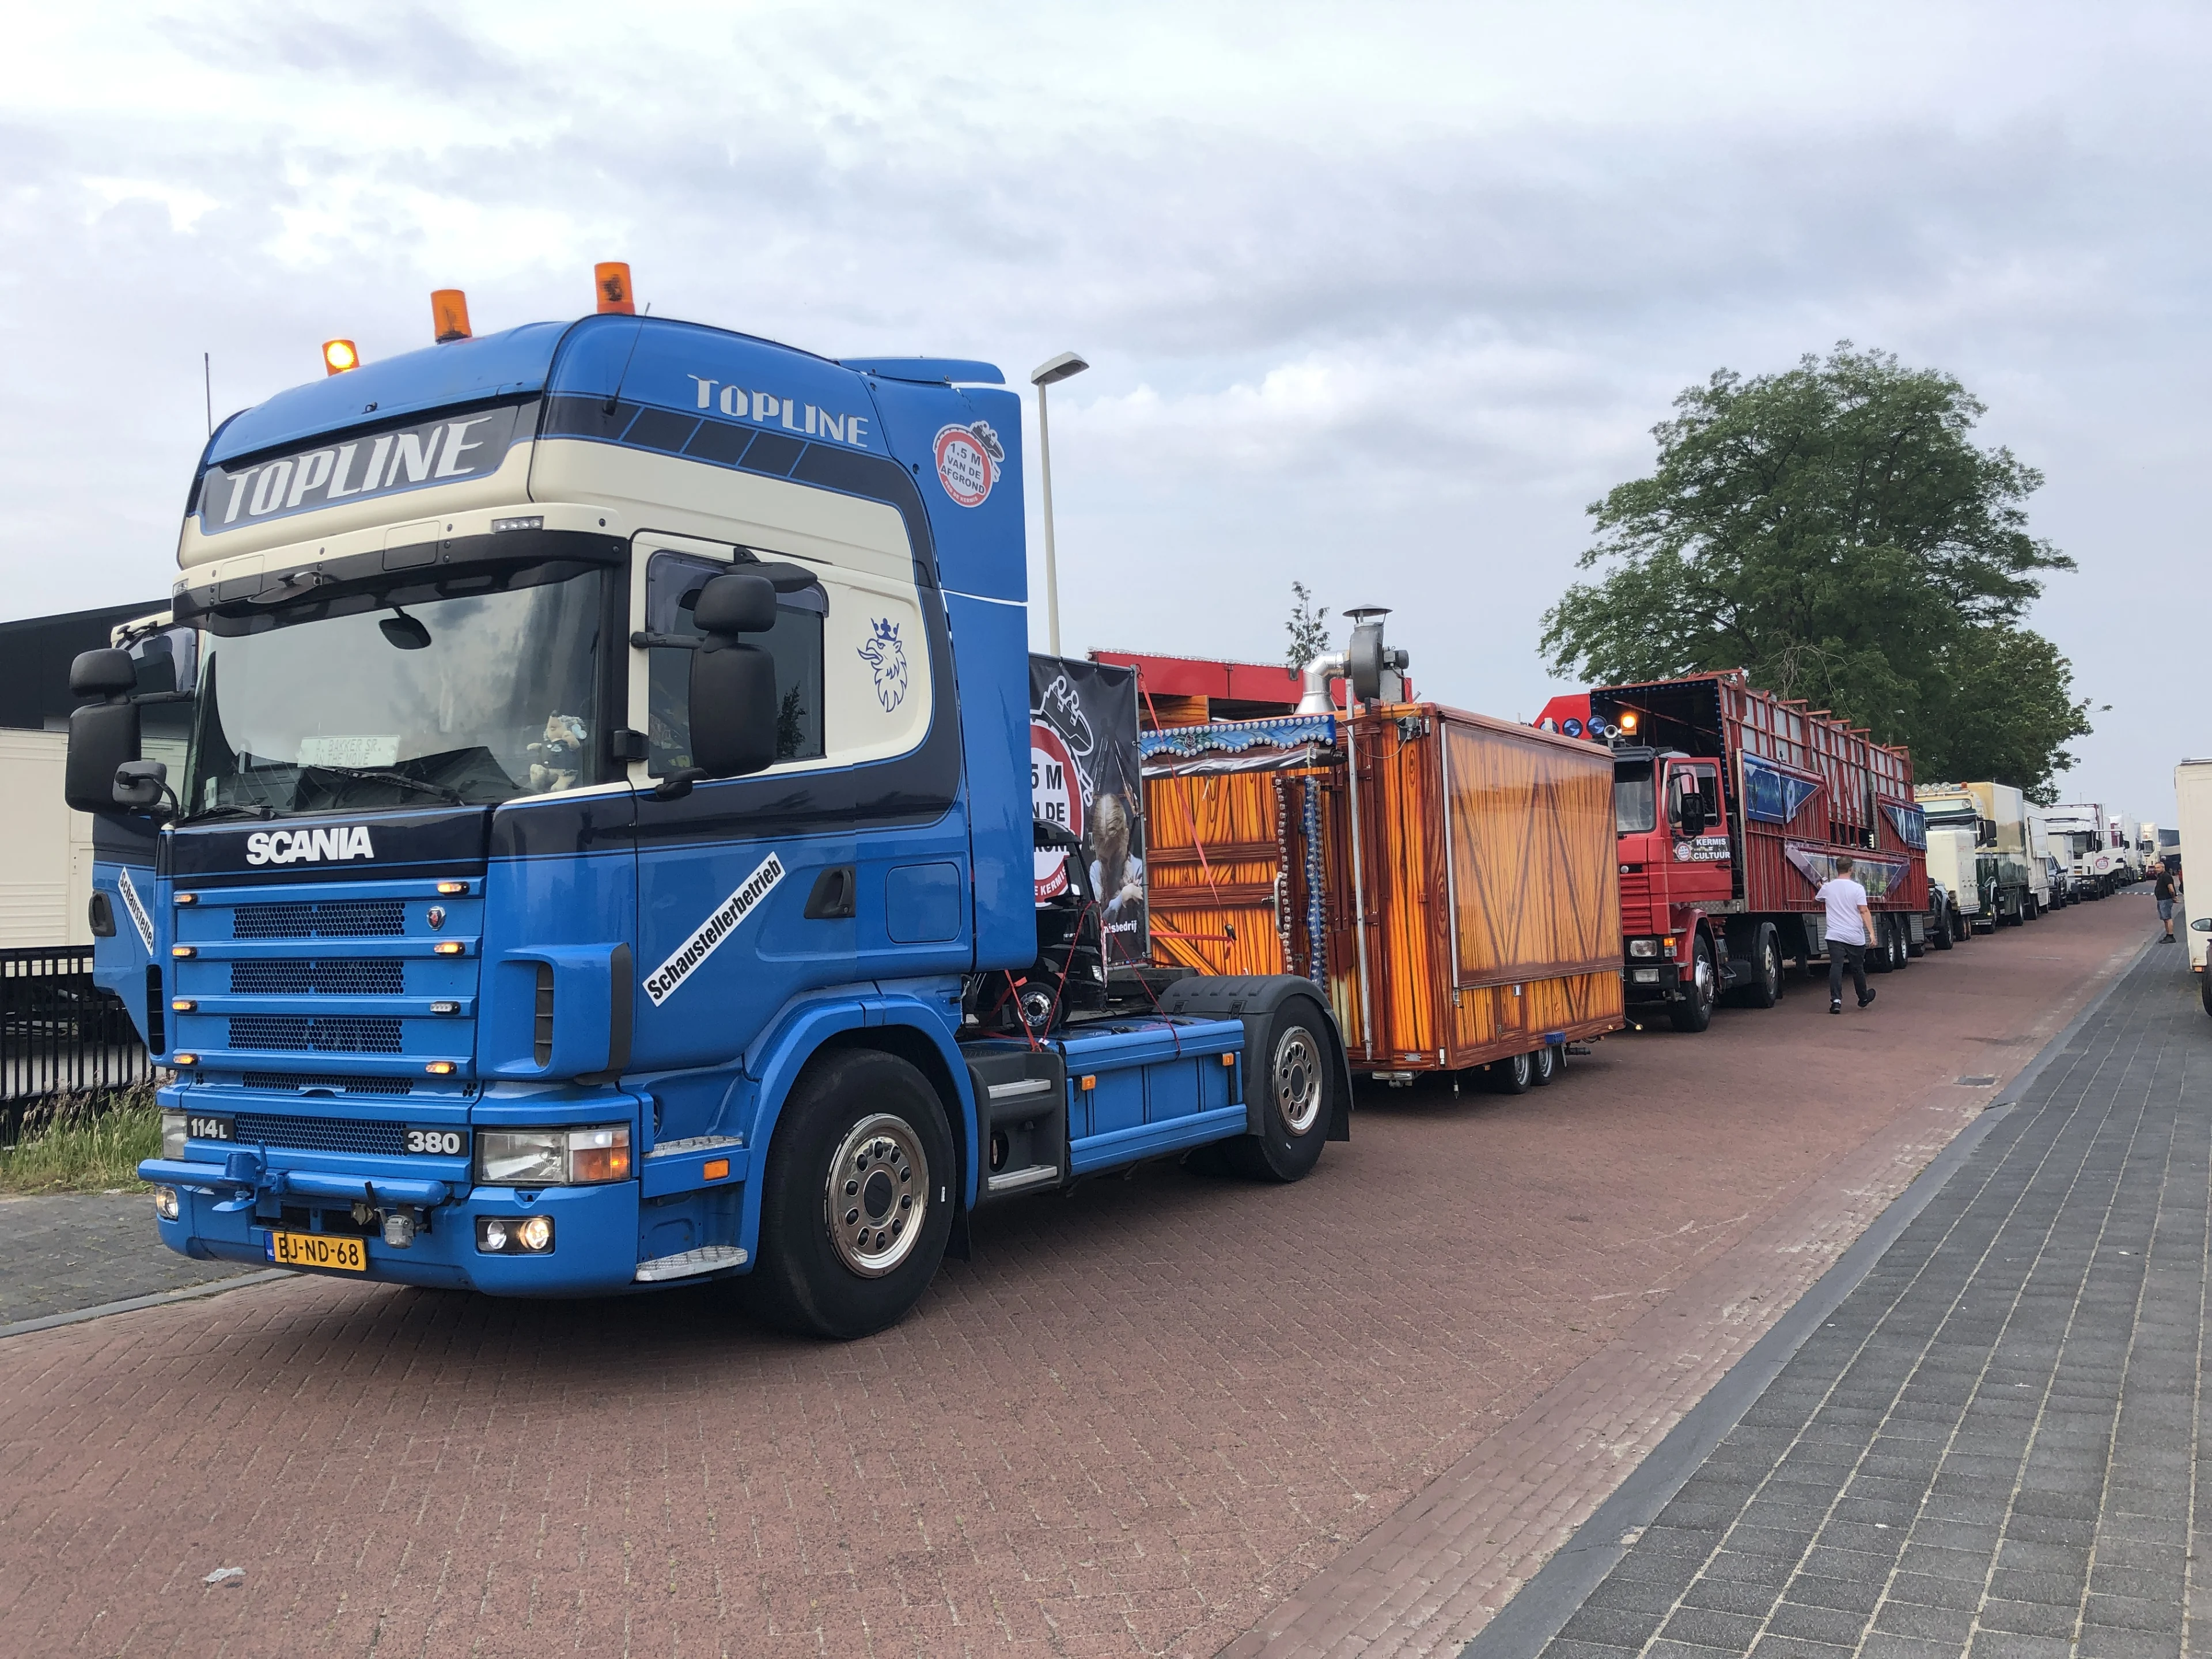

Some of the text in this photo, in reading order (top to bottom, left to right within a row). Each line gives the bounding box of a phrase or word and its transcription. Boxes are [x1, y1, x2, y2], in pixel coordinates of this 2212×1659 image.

[687, 374, 869, 448] TOPLINE
[948, 455, 982, 480] VAN DE
[950, 443, 981, 467] 1.5 M
[224, 416, 493, 524] TOPLINE
[941, 465, 985, 494] AFGROND
[328, 738, 362, 752] BAKKER
[328, 752, 343, 766] THE
[346, 752, 370, 766] MOVE
[1046, 764, 1062, 790] M
[1046, 802, 1065, 822] DE
[246, 826, 374, 865] SCANIA
[1694, 851, 1730, 859] CULTUUR
[647, 859, 781, 999] Schaustellerbetrieb
[408, 1131, 460, 1154] 380
[279, 1237, 359, 1266] BJ-ND-68
